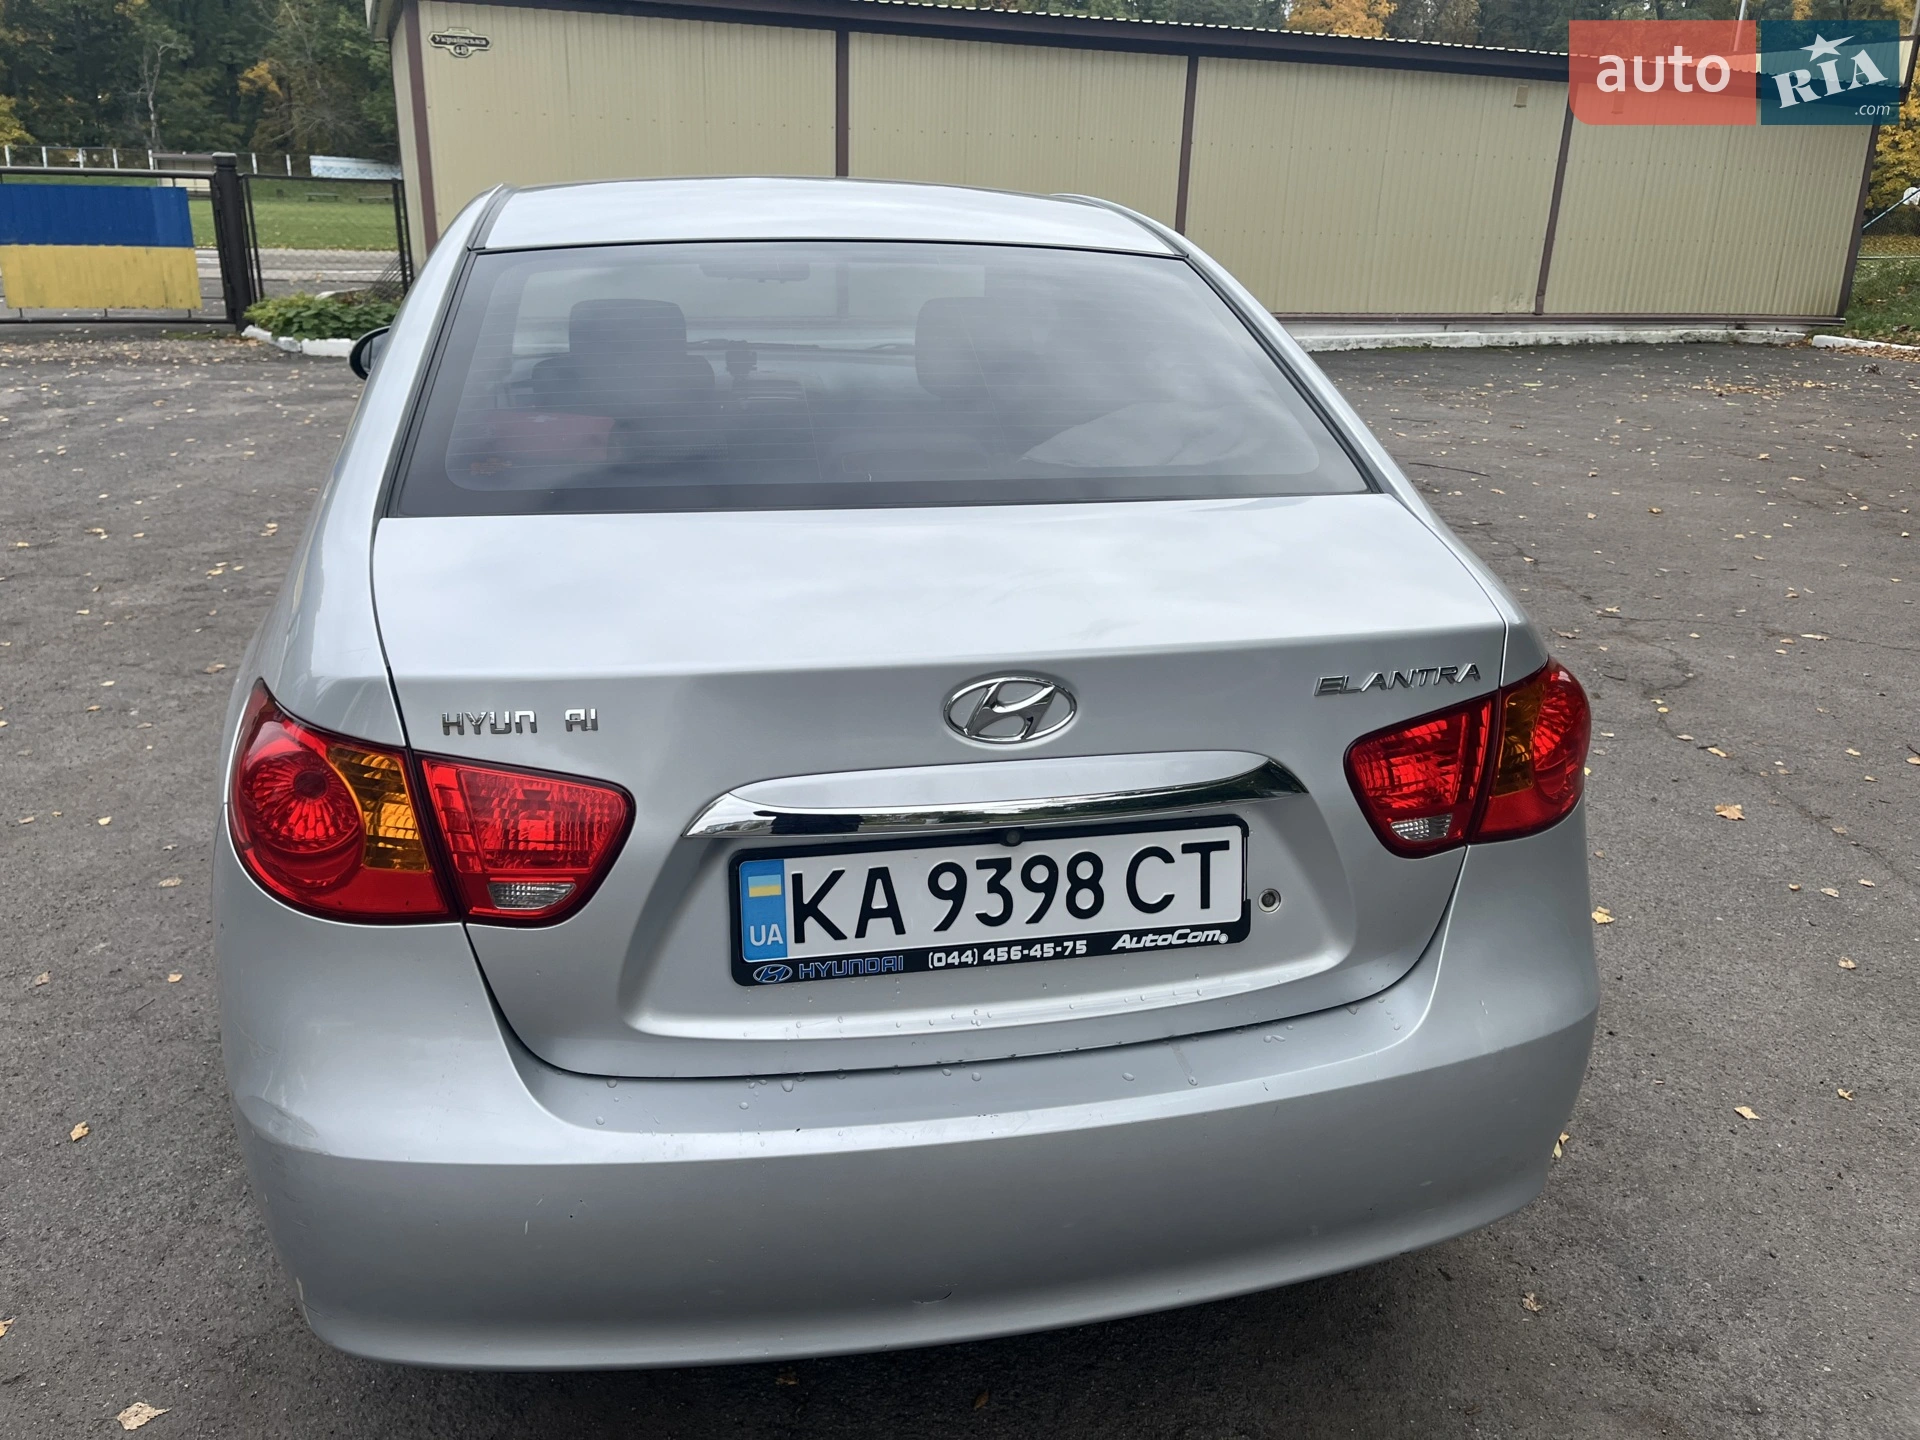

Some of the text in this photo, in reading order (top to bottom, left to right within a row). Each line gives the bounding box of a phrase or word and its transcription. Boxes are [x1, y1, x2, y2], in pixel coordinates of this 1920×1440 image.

[1314, 662, 1482, 697] ELANTRA
[791, 840, 1230, 944] KA 9398 CT
[750, 923, 784, 946] UA
[798, 955, 904, 980] HYUNDAI
[928, 951, 979, 970] (044)
[982, 940, 1088, 963] 456-45-75
